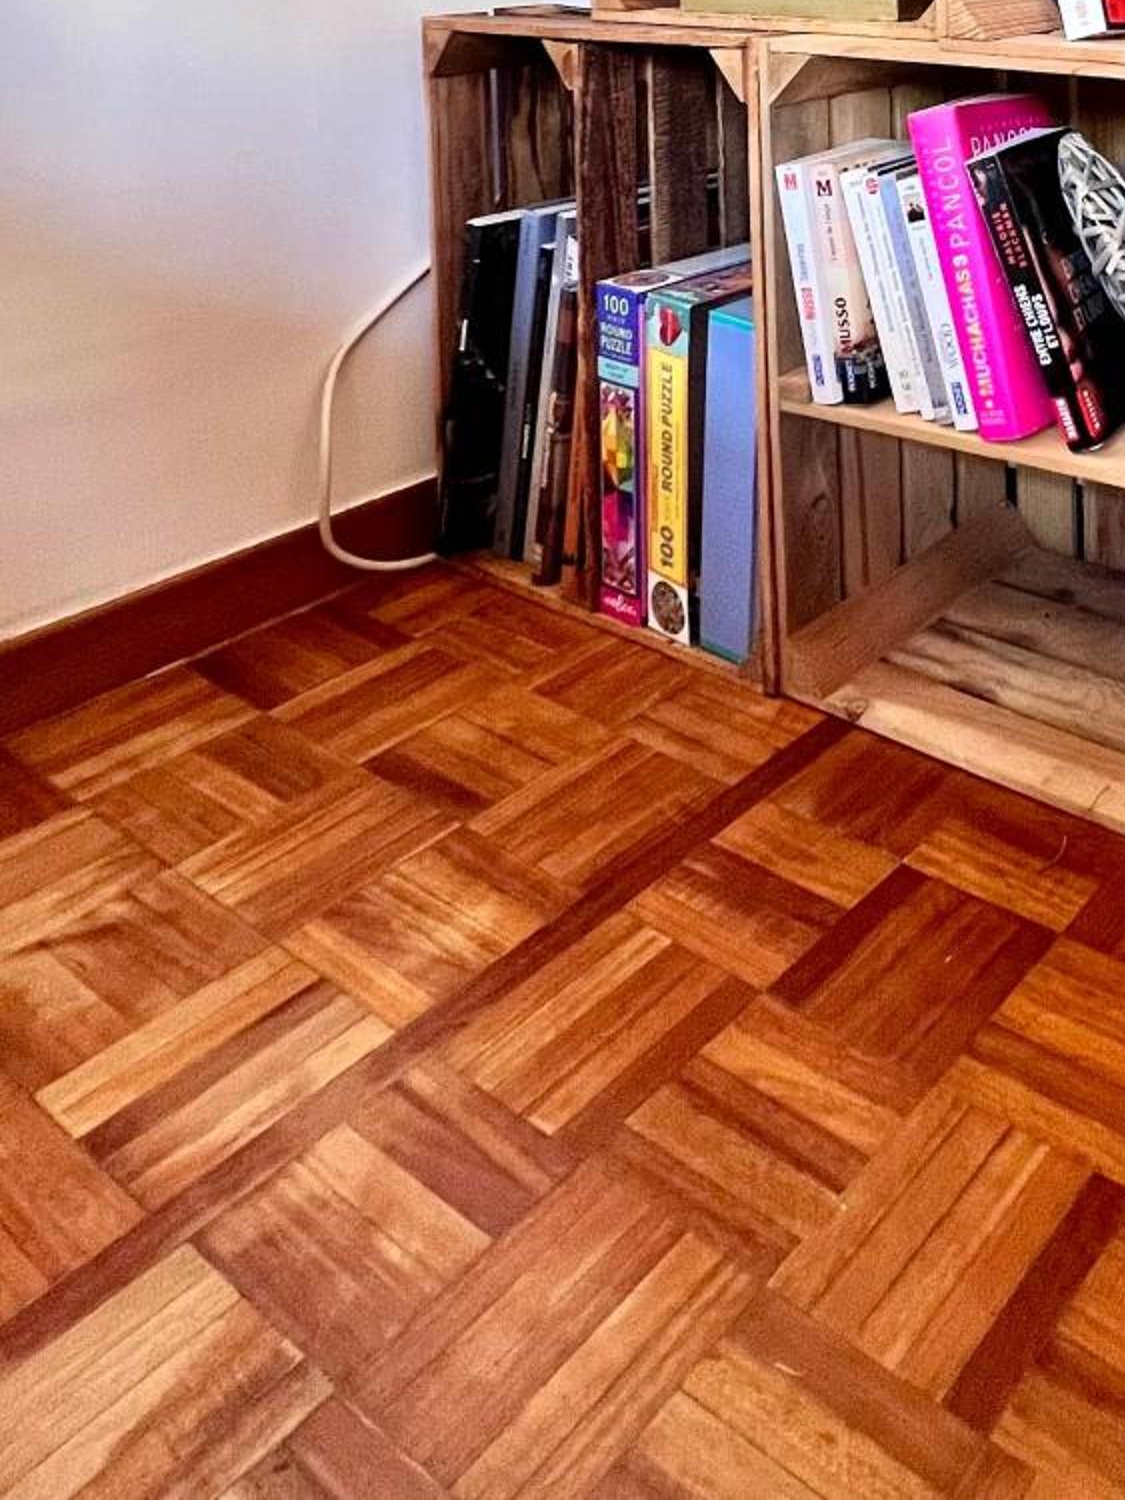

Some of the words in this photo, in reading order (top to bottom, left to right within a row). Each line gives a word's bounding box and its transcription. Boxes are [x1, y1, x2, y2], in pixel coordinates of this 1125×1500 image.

[933, 141, 967, 248] PANCOL
[603, 293, 630, 317] 100
[834, 296, 854, 355] MUSSO
[1012, 281, 1038, 330] CHIENS
[1029, 292, 1052, 332] LOUPS
[600, 334, 633, 357] PUZZLE
[955, 268, 995, 398] MUCHACHAS
[1029, 329, 1052, 367] ENTRE
[1042, 330, 1059, 350] ET
[658, 361, 675, 428] PUZZLE
[659, 428, 674, 493] ROUND
[658, 524, 674, 568] 100
